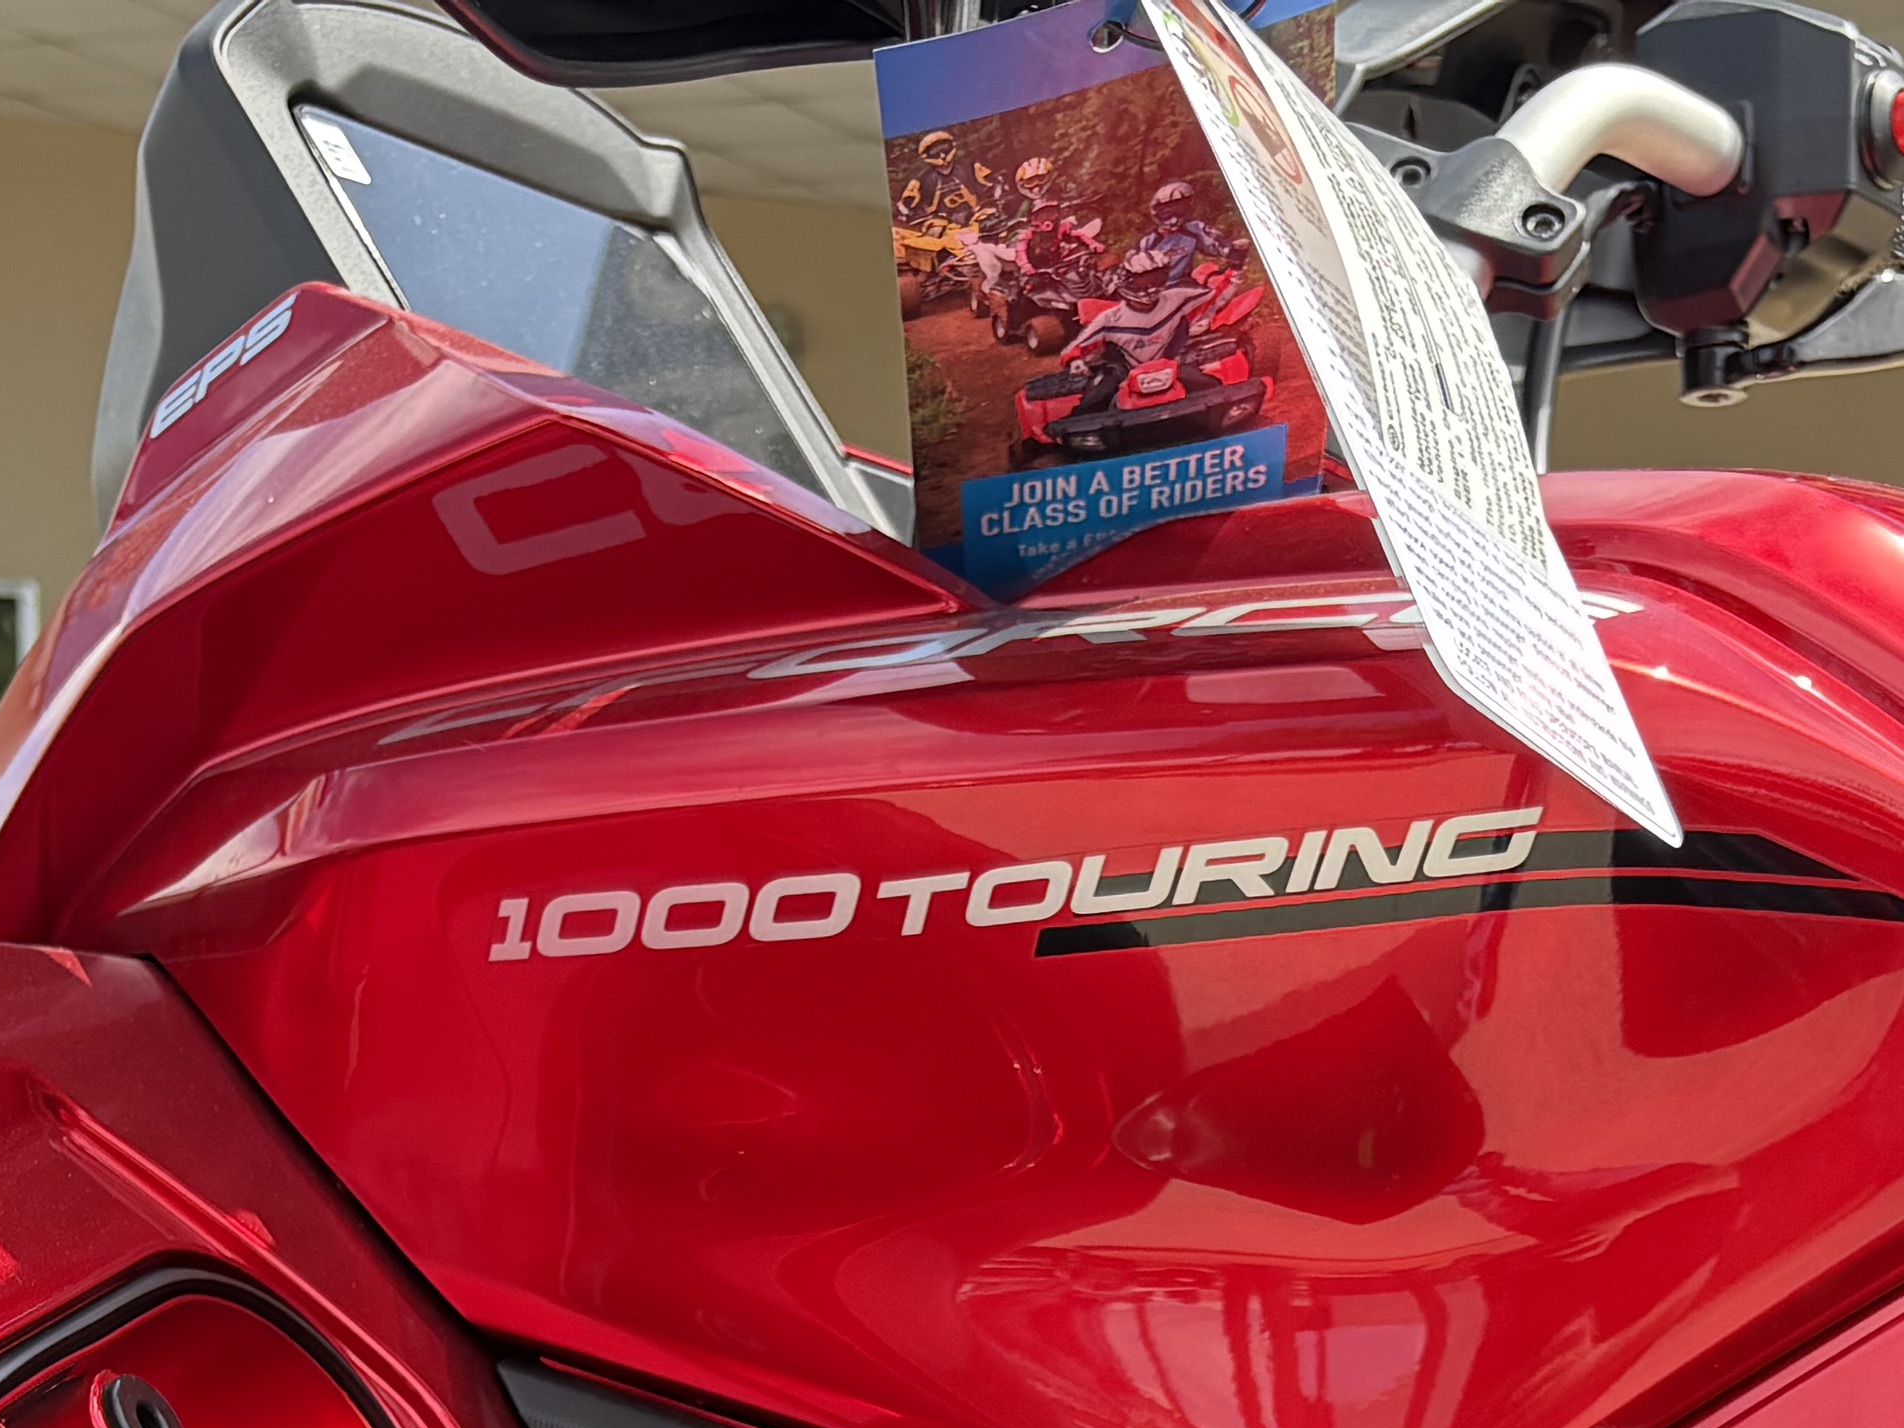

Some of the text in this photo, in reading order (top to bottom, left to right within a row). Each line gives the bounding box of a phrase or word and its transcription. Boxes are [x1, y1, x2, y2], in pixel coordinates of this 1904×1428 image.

[149, 291, 298, 438] EPS
[980, 464, 1268, 537] CLASS OF RIDERS
[1004, 443, 1245, 508] JOIN A BETTER
[488, 806, 1544, 963] 1000 TOURING
